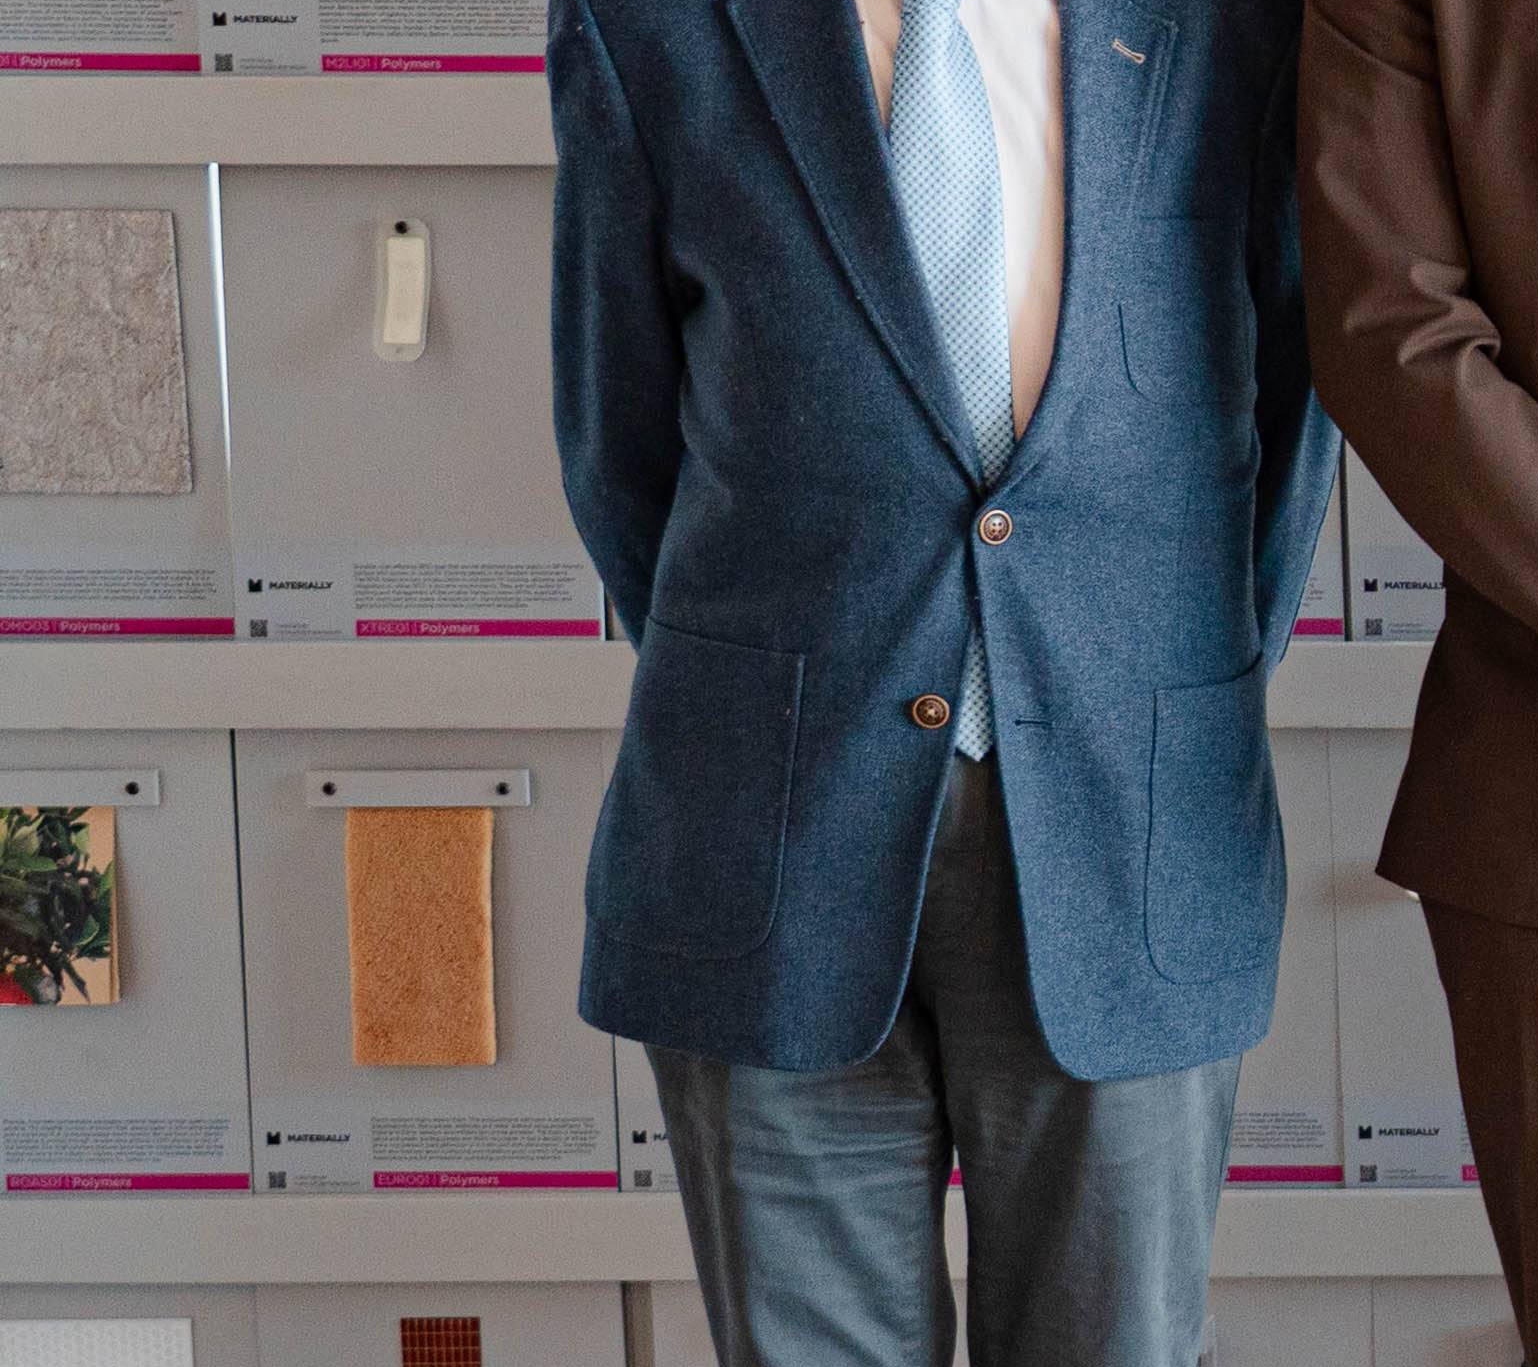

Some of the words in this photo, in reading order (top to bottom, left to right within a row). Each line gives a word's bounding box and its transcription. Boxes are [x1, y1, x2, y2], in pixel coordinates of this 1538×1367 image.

[233, 15, 298, 24] MATERIALLY
[20, 56, 82, 69] Polymers
[381, 58, 442, 71] Polymers
[269, 581, 333, 590] MATERIALLY
[60, 621, 121, 634] Polymers
[420, 623, 480, 635] Polymers
[287, 1133, 350, 1143] MATERIALLY
[1378, 1128, 1440, 1137] MATERIALLY
[72, 1176, 132, 1188] Polymers
[440, 1174, 500, 1187] Polymers
